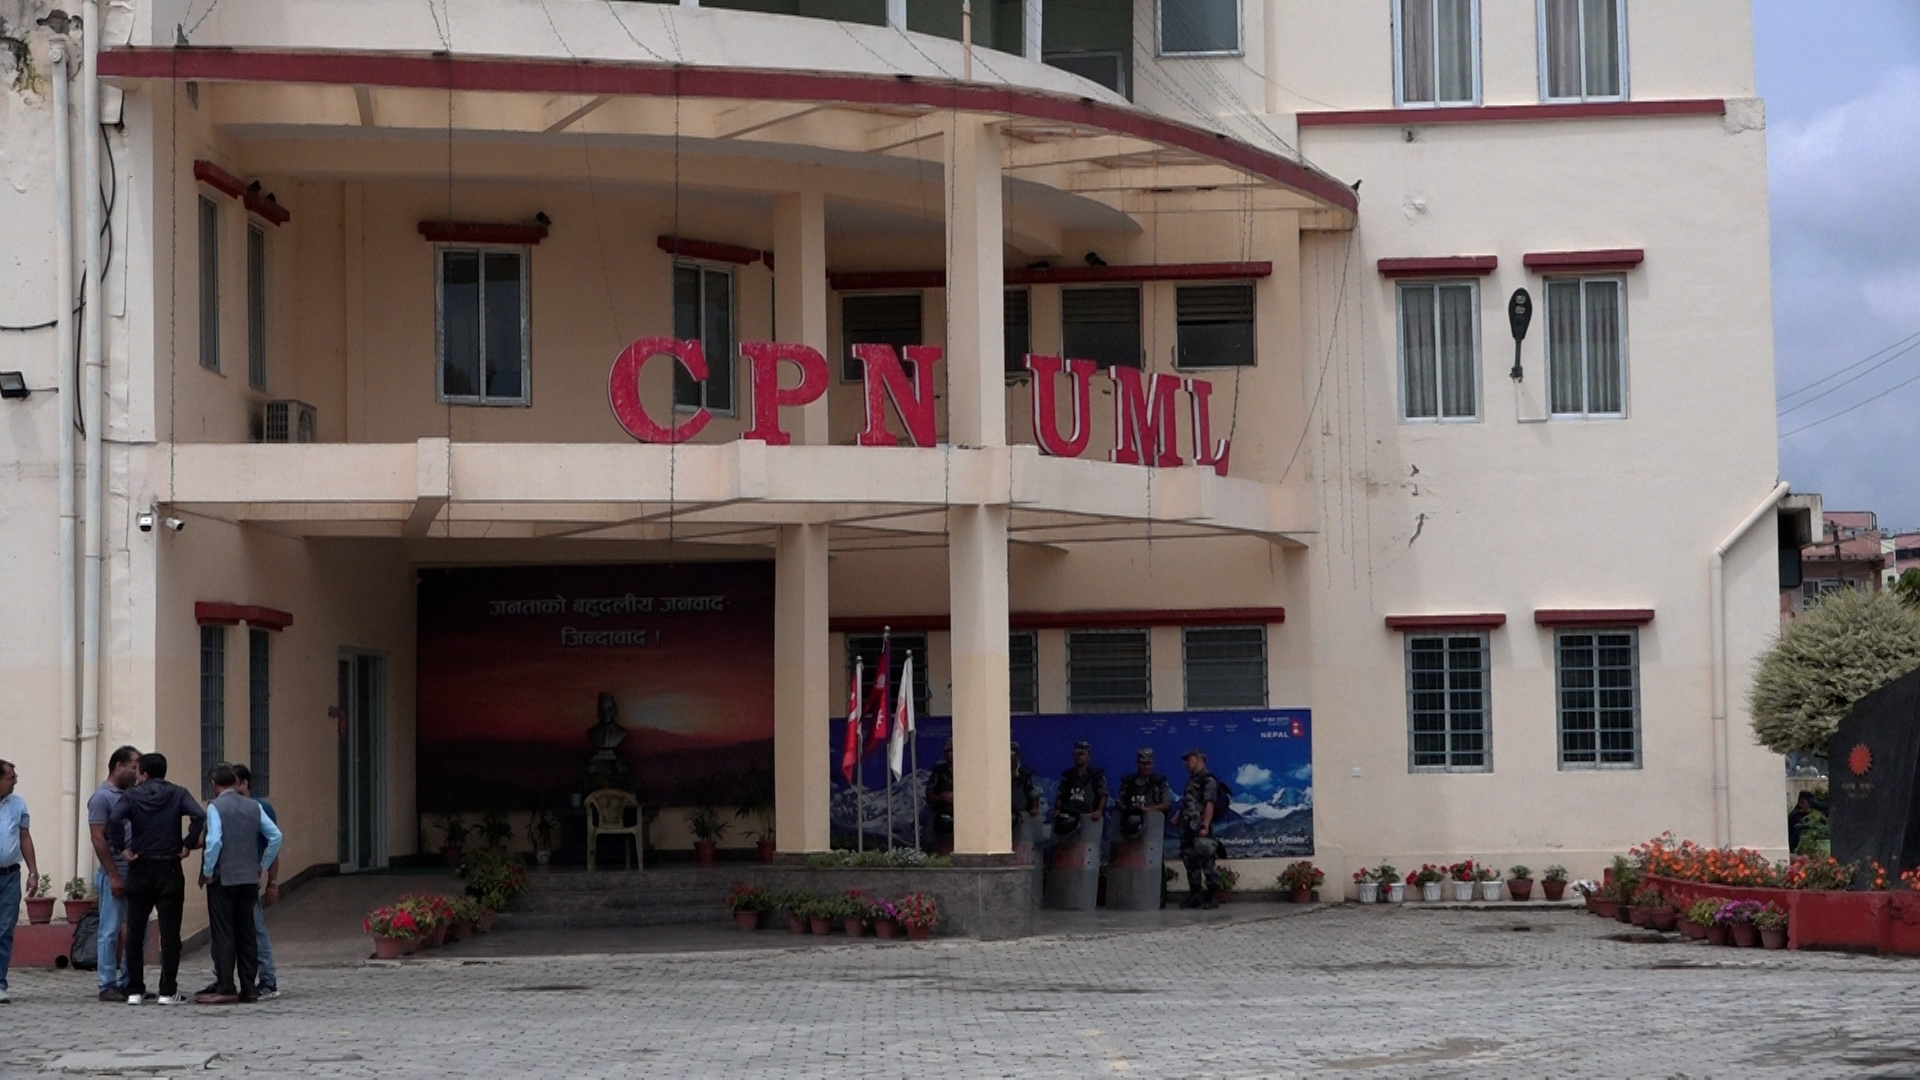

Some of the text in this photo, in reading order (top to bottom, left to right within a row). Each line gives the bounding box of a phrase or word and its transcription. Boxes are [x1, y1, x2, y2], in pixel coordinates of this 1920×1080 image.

[607, 336, 1230, 476] CPN UML
[489, 592, 725, 618] जनताको बहुदलीय जनवाद
[560, 626, 648, 646] जिन्दावाद
